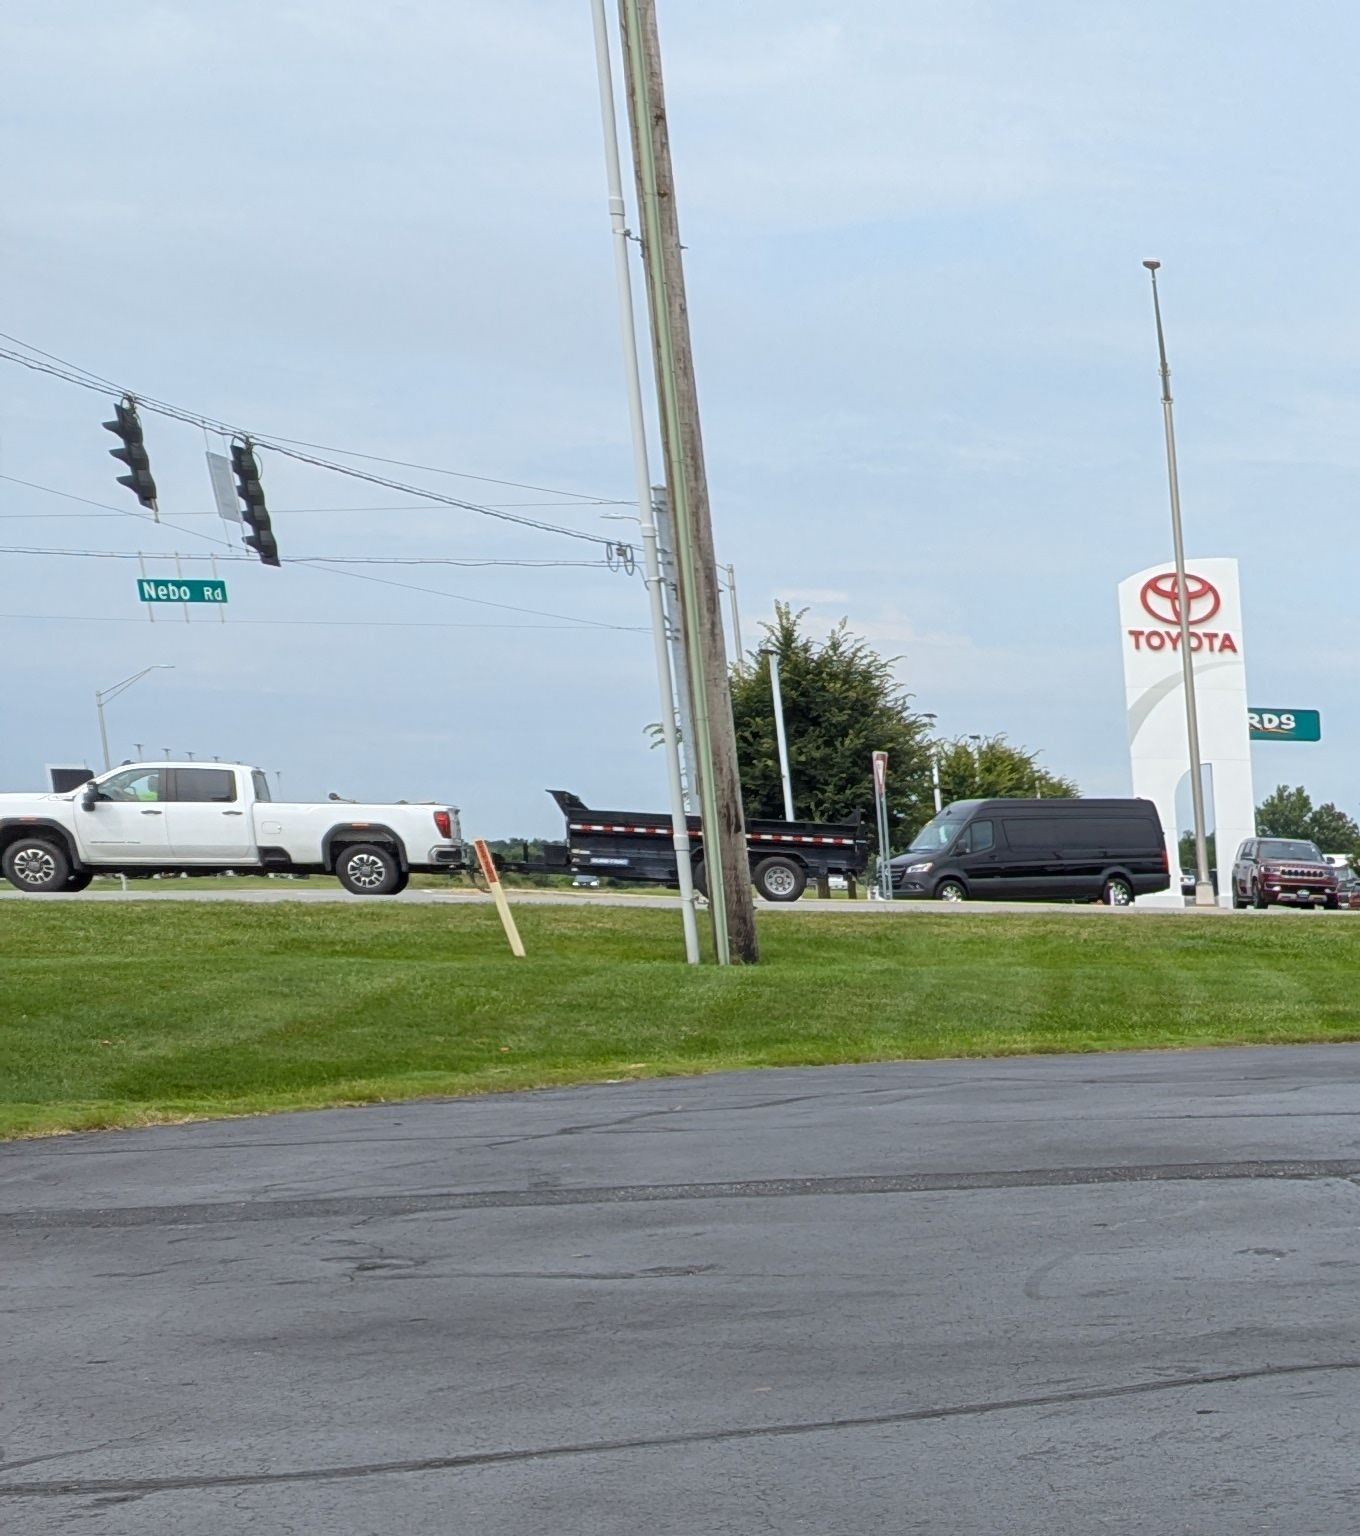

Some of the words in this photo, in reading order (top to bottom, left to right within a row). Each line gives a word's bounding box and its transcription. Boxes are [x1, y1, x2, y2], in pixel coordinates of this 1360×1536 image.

[141, 581, 191, 600] Nebo
[203, 586, 223, 601] Rd
[1128, 629, 1239, 654] TOYOTA
